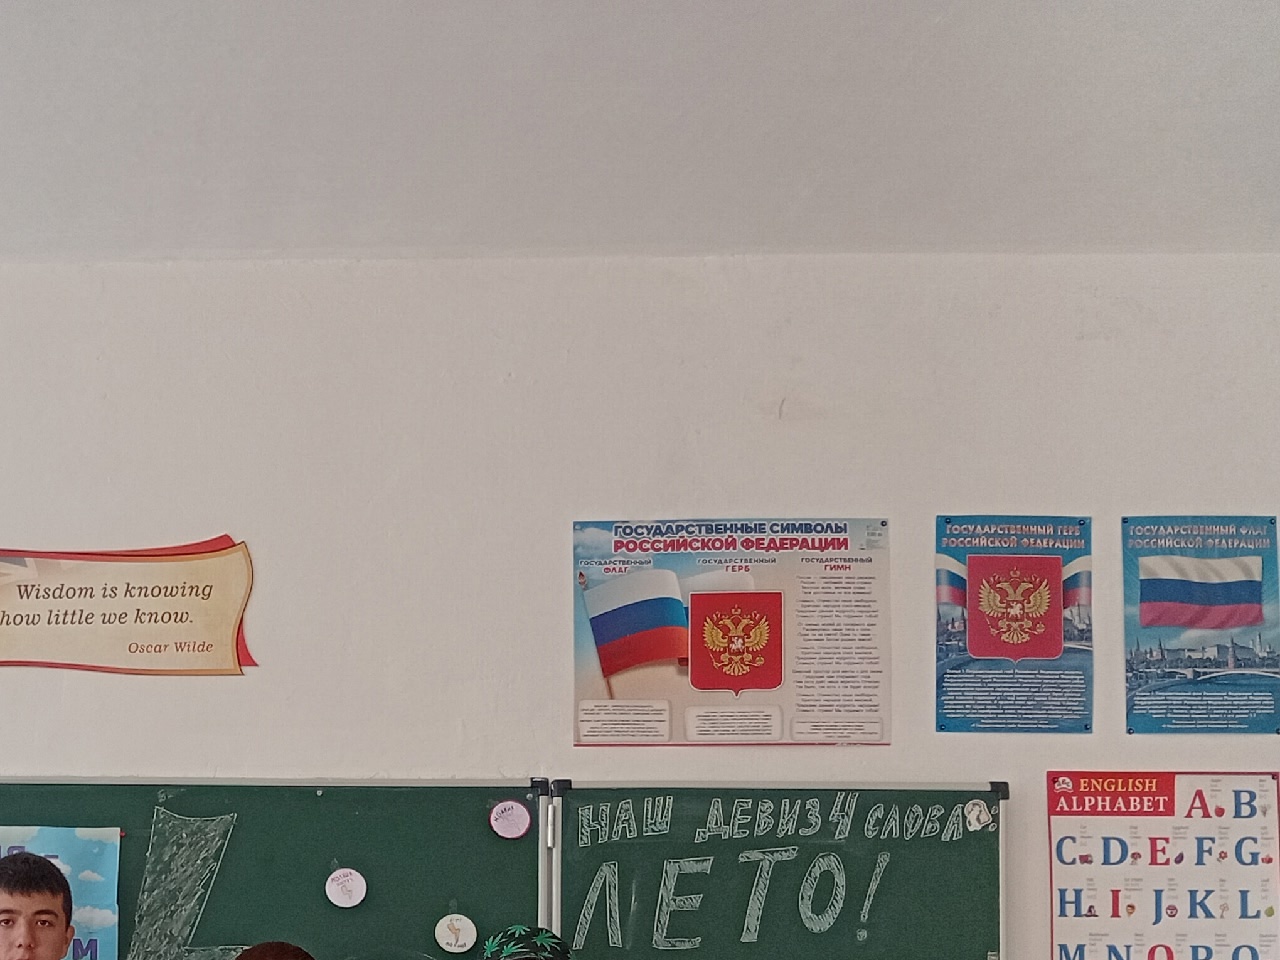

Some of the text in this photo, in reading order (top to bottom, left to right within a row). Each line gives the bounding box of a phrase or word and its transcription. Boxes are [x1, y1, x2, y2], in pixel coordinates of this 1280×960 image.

[614, 522, 847, 537] ГОСУДАРСТВЕННЫЕ СИМВОЛЫ
[946, 524, 1081, 536] ГОСУДАРСТВЕННЫЙ ГЕРБ
[1130, 524, 1267, 536] ГОСУДАРСТВЕННЫЙ ФЛАГ
[613, 535, 849, 553] РОССИЙСКОЙ ФЕДЕРАЦИИ
[941, 536, 1085, 550] РОССИЙСКОЙ ФЕДЕРАЦИИ
[1128, 536, 1270, 549] РОССИЙСКОЙ ФЕДЕРАЦИИ
[580, 558, 652, 566] ГОСУДАРСТВЕННЫЙ
[801, 556, 873, 564] ГОСУДАРСТВЕННЫЙ
[603, 566, 629, 574] ФЛАГ
[16, 581, 213, 601] Wisdom is knowing
[0, 608, 194, 626] how little we know.
[128, 640, 214, 654] Oscar Wilde
[1079, 778, 1158, 792] ENGLISH
[1056, 796, 1169, 812] ALPHABET
[1184, 789, 1258, 819] A B
[578, 796, 673, 847] НАШ
[694, 797, 822, 843] ДЕВИЗ
[829, 792, 859, 840] 4
[1056, 835, 1077, 866] C
[1101, 836, 1129, 866] D
[1148, 836, 1171, 866] E
[1194, 836, 1216, 866] F
[1234, 836, 1261, 866] G
[572, 846, 891, 950] ЛЕТО!
[1057, 888, 1085, 918] H
[1110, 889, 1122, 918] I
[1151, 889, 1164, 926] J
[1187, 889, 1216, 919] K
[1238, 889, 1261, 920] L
